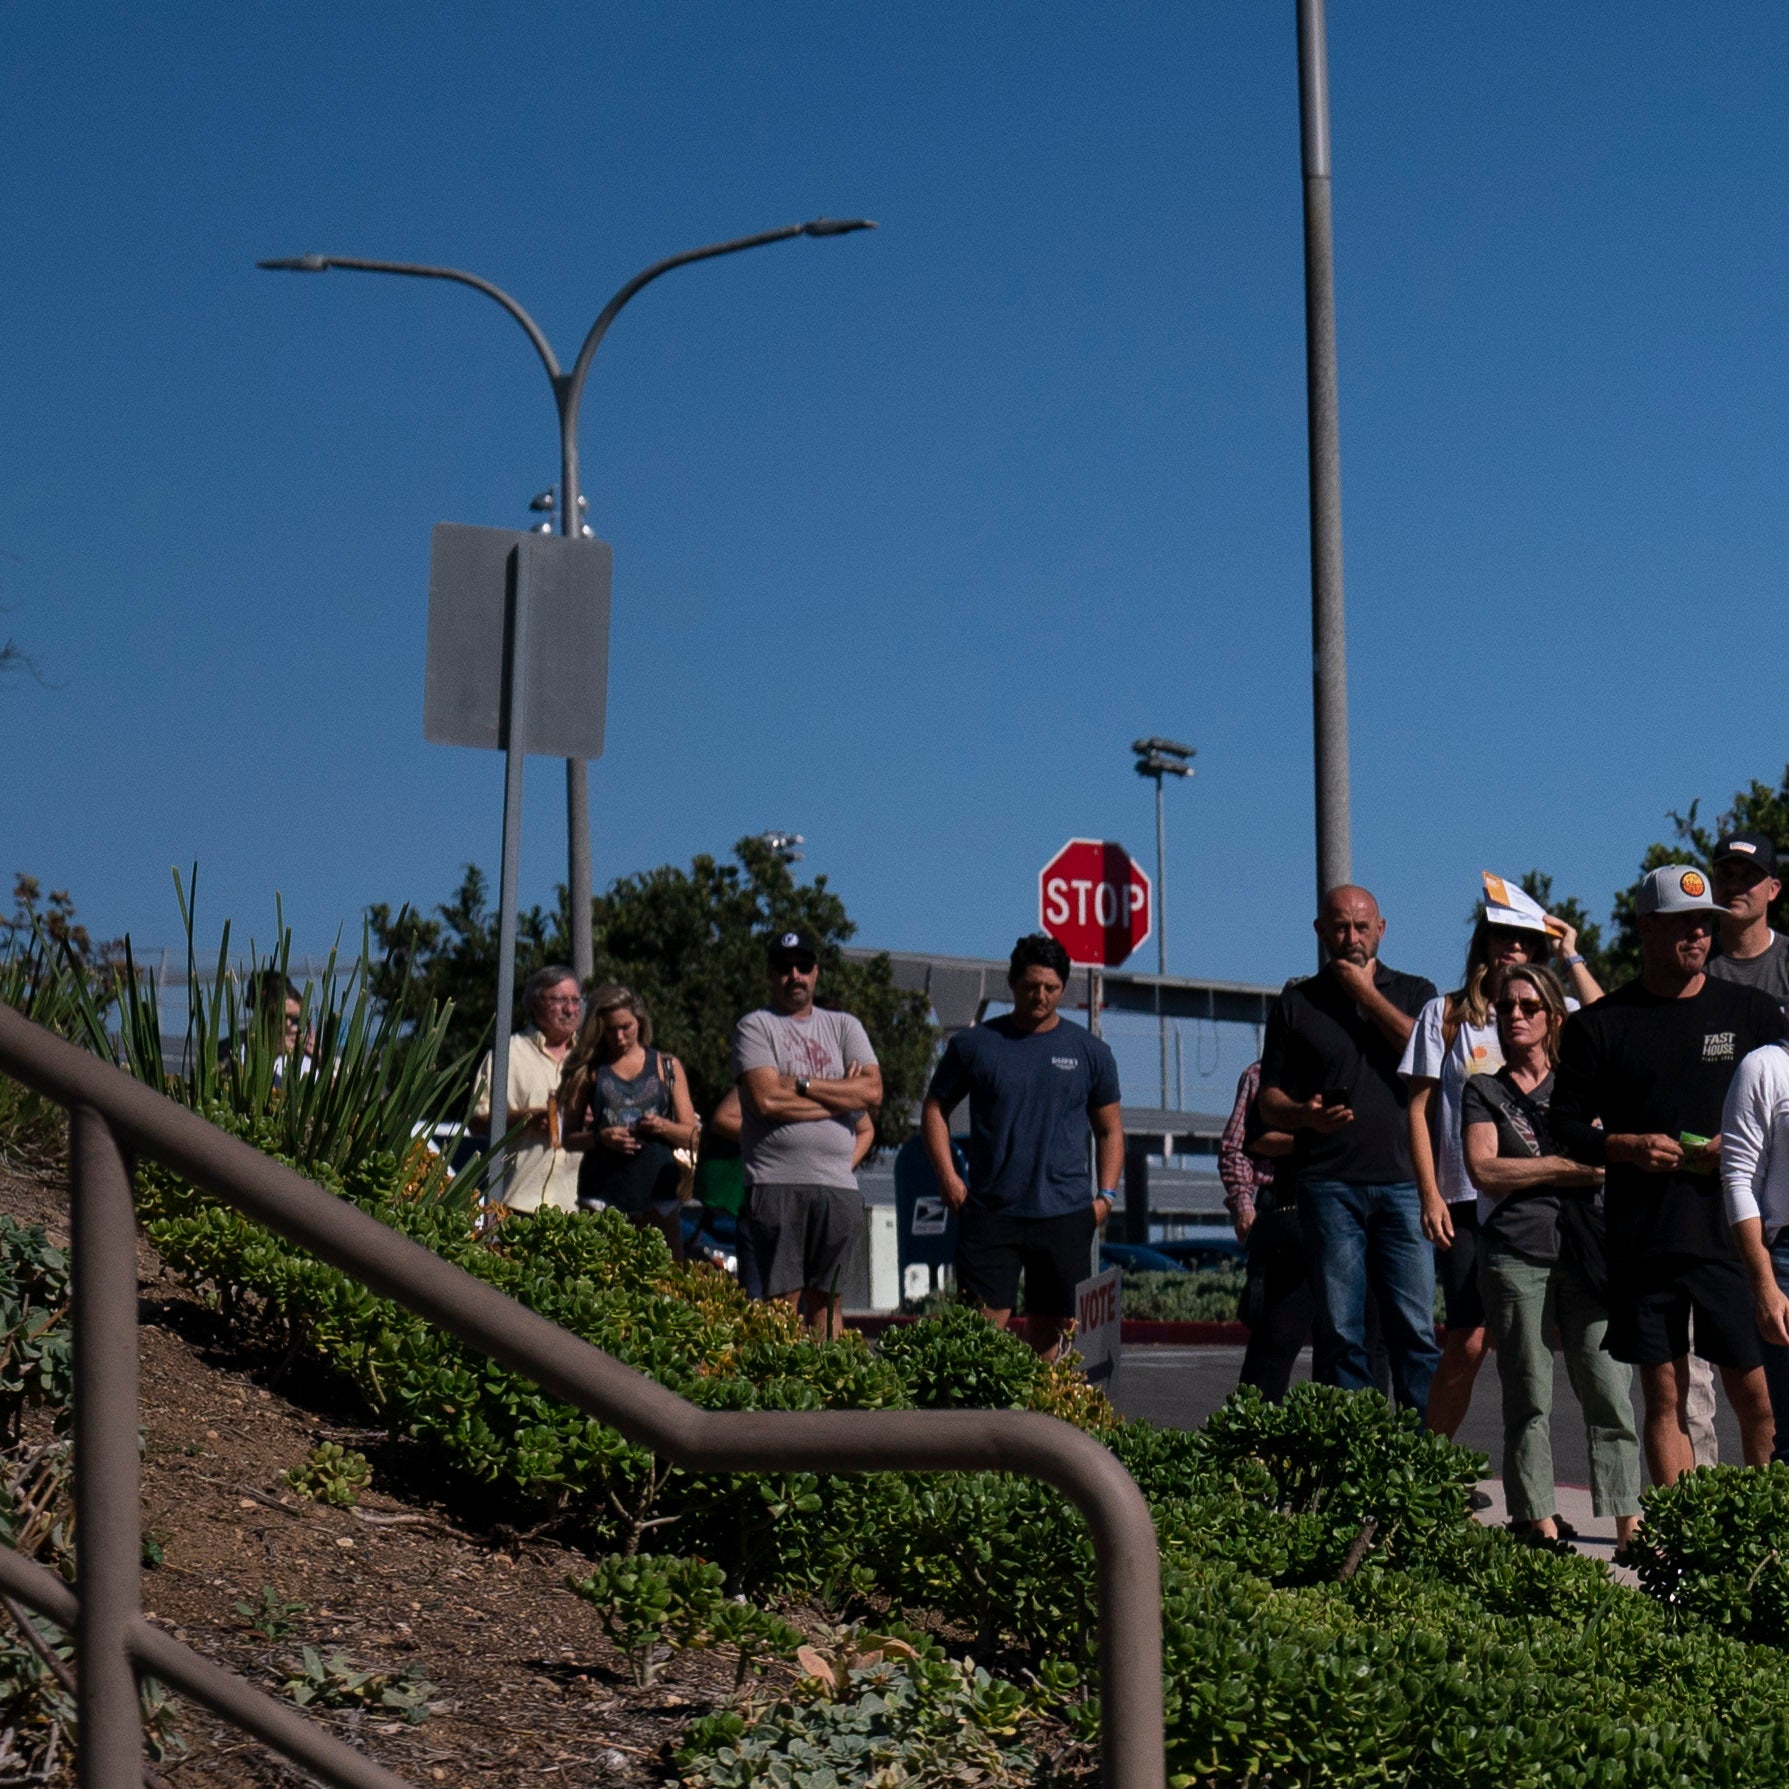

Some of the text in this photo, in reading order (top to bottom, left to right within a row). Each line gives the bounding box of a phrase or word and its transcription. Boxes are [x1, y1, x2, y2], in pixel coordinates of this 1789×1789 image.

[1045, 877, 1145, 929] STOP
[1702, 1043, 1735, 1056] HOUSE
[1704, 1031, 1736, 1045] FAST
[1080, 1281, 1116, 1335] VOTE
